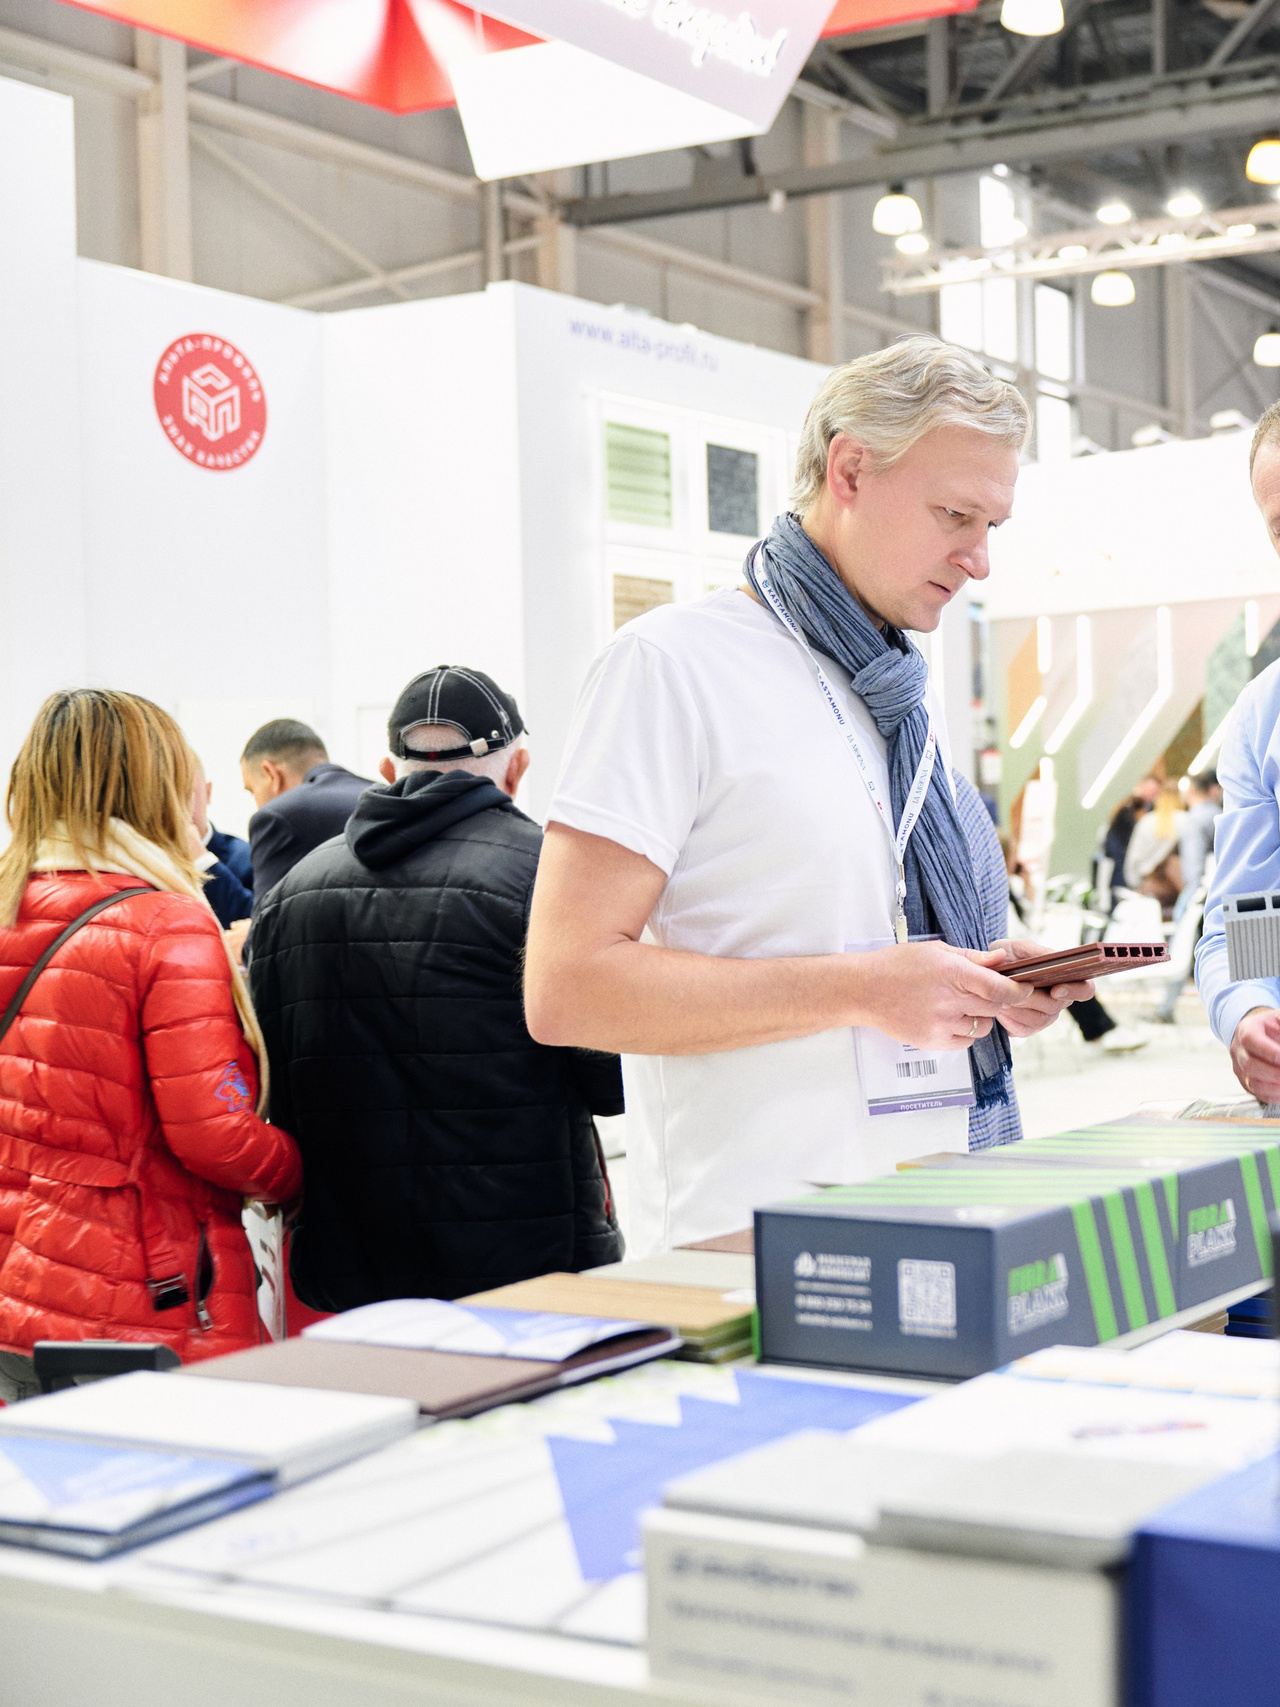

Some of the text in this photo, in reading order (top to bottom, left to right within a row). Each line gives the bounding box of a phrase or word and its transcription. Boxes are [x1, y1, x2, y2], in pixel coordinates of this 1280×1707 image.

[767, 587, 800, 633] KASTAMONU
[819, 677, 846, 726] ASTAMONU
[900, 1100, 943, 1110] ПОСЕТИТЕЛЬ
[1187, 1223, 1237, 1260] PLANK
[1007, 1280, 1069, 1324] PLANK
